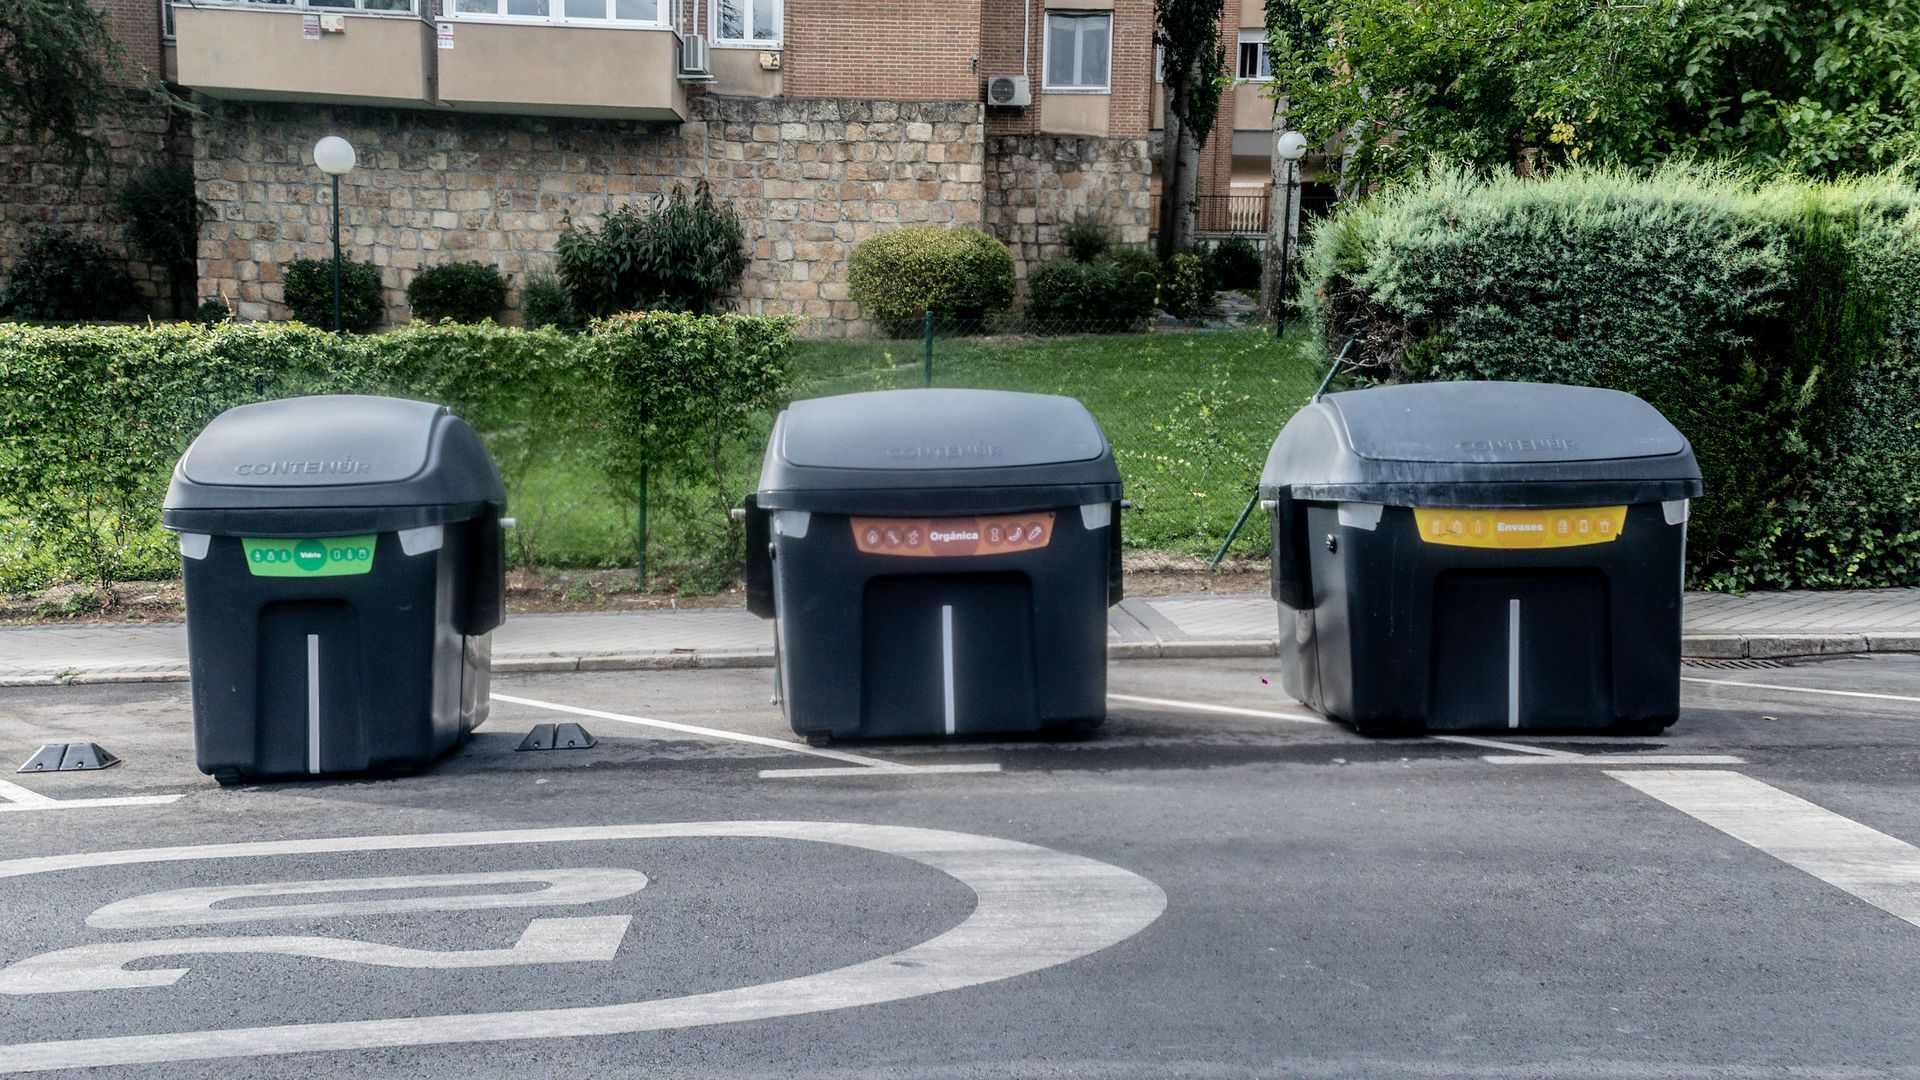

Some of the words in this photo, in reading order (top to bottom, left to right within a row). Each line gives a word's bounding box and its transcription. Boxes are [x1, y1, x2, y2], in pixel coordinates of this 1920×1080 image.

[1497, 522, 1545, 532] Envases
[929, 531, 979, 543] Orgánica
[300, 551, 321, 559] Vidrio
